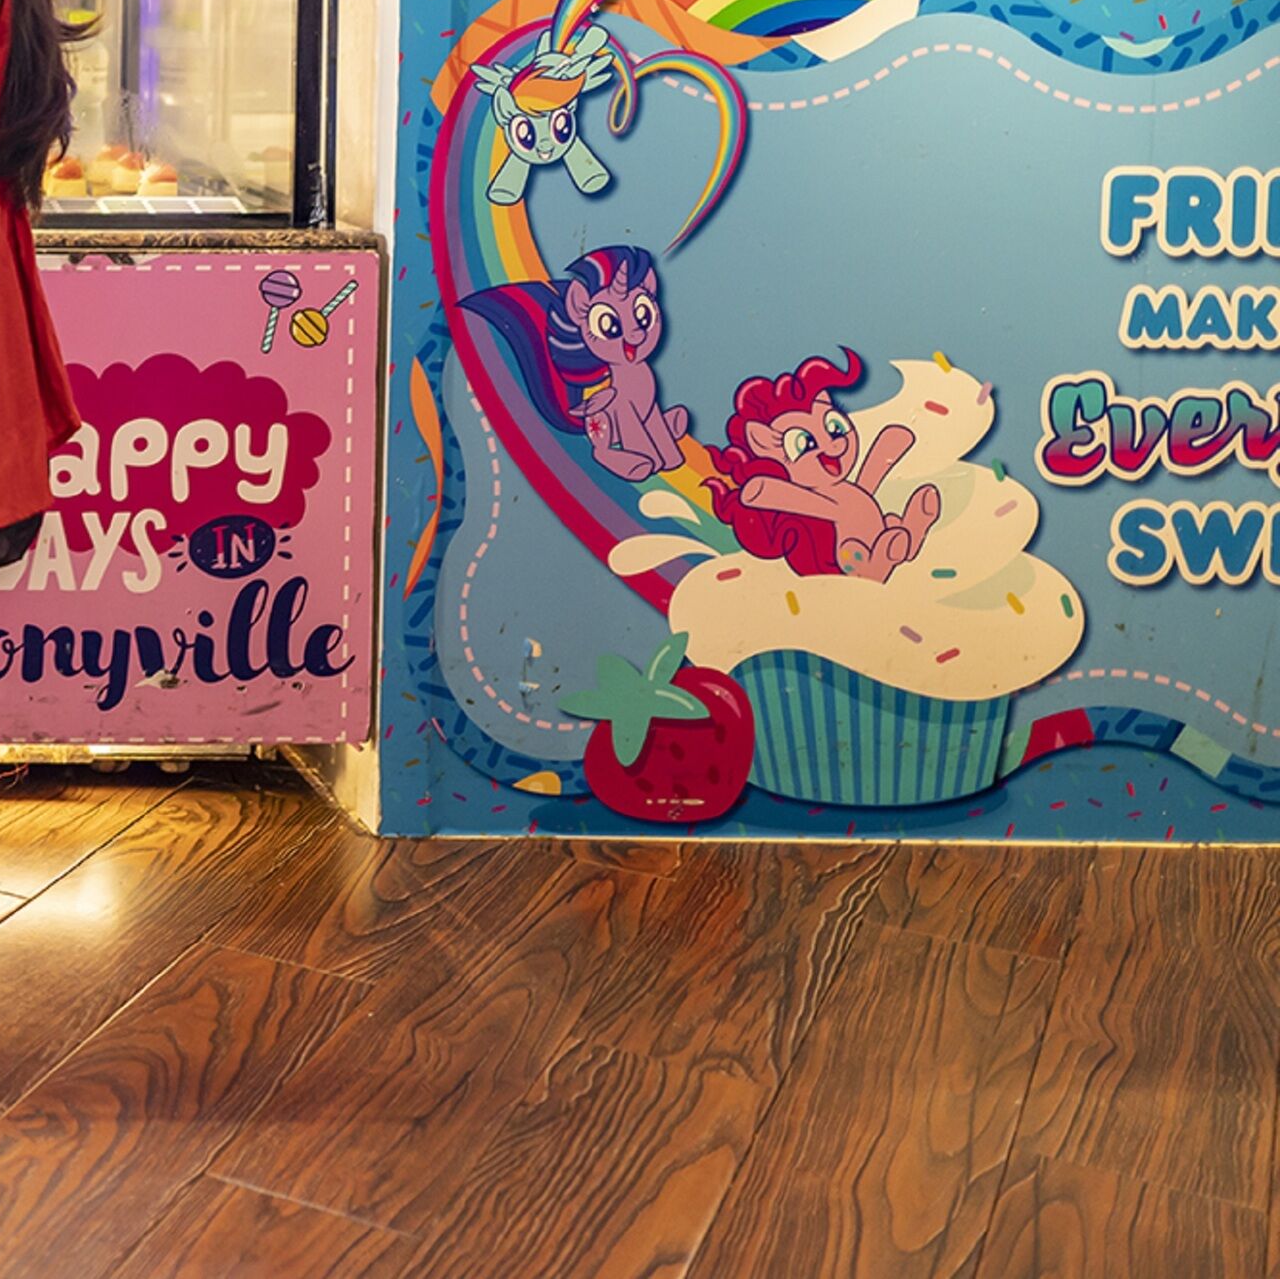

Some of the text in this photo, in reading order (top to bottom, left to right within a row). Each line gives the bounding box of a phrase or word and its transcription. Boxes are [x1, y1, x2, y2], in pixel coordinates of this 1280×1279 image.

[1104, 170, 1280, 253] FRI
[1123, 288, 1280, 346] MAK
[49, 418, 288, 504] appy
[1042, 376, 1280, 480] Ever
[209, 523, 257, 570] IN
[1111, 505, 1280, 583] SW
